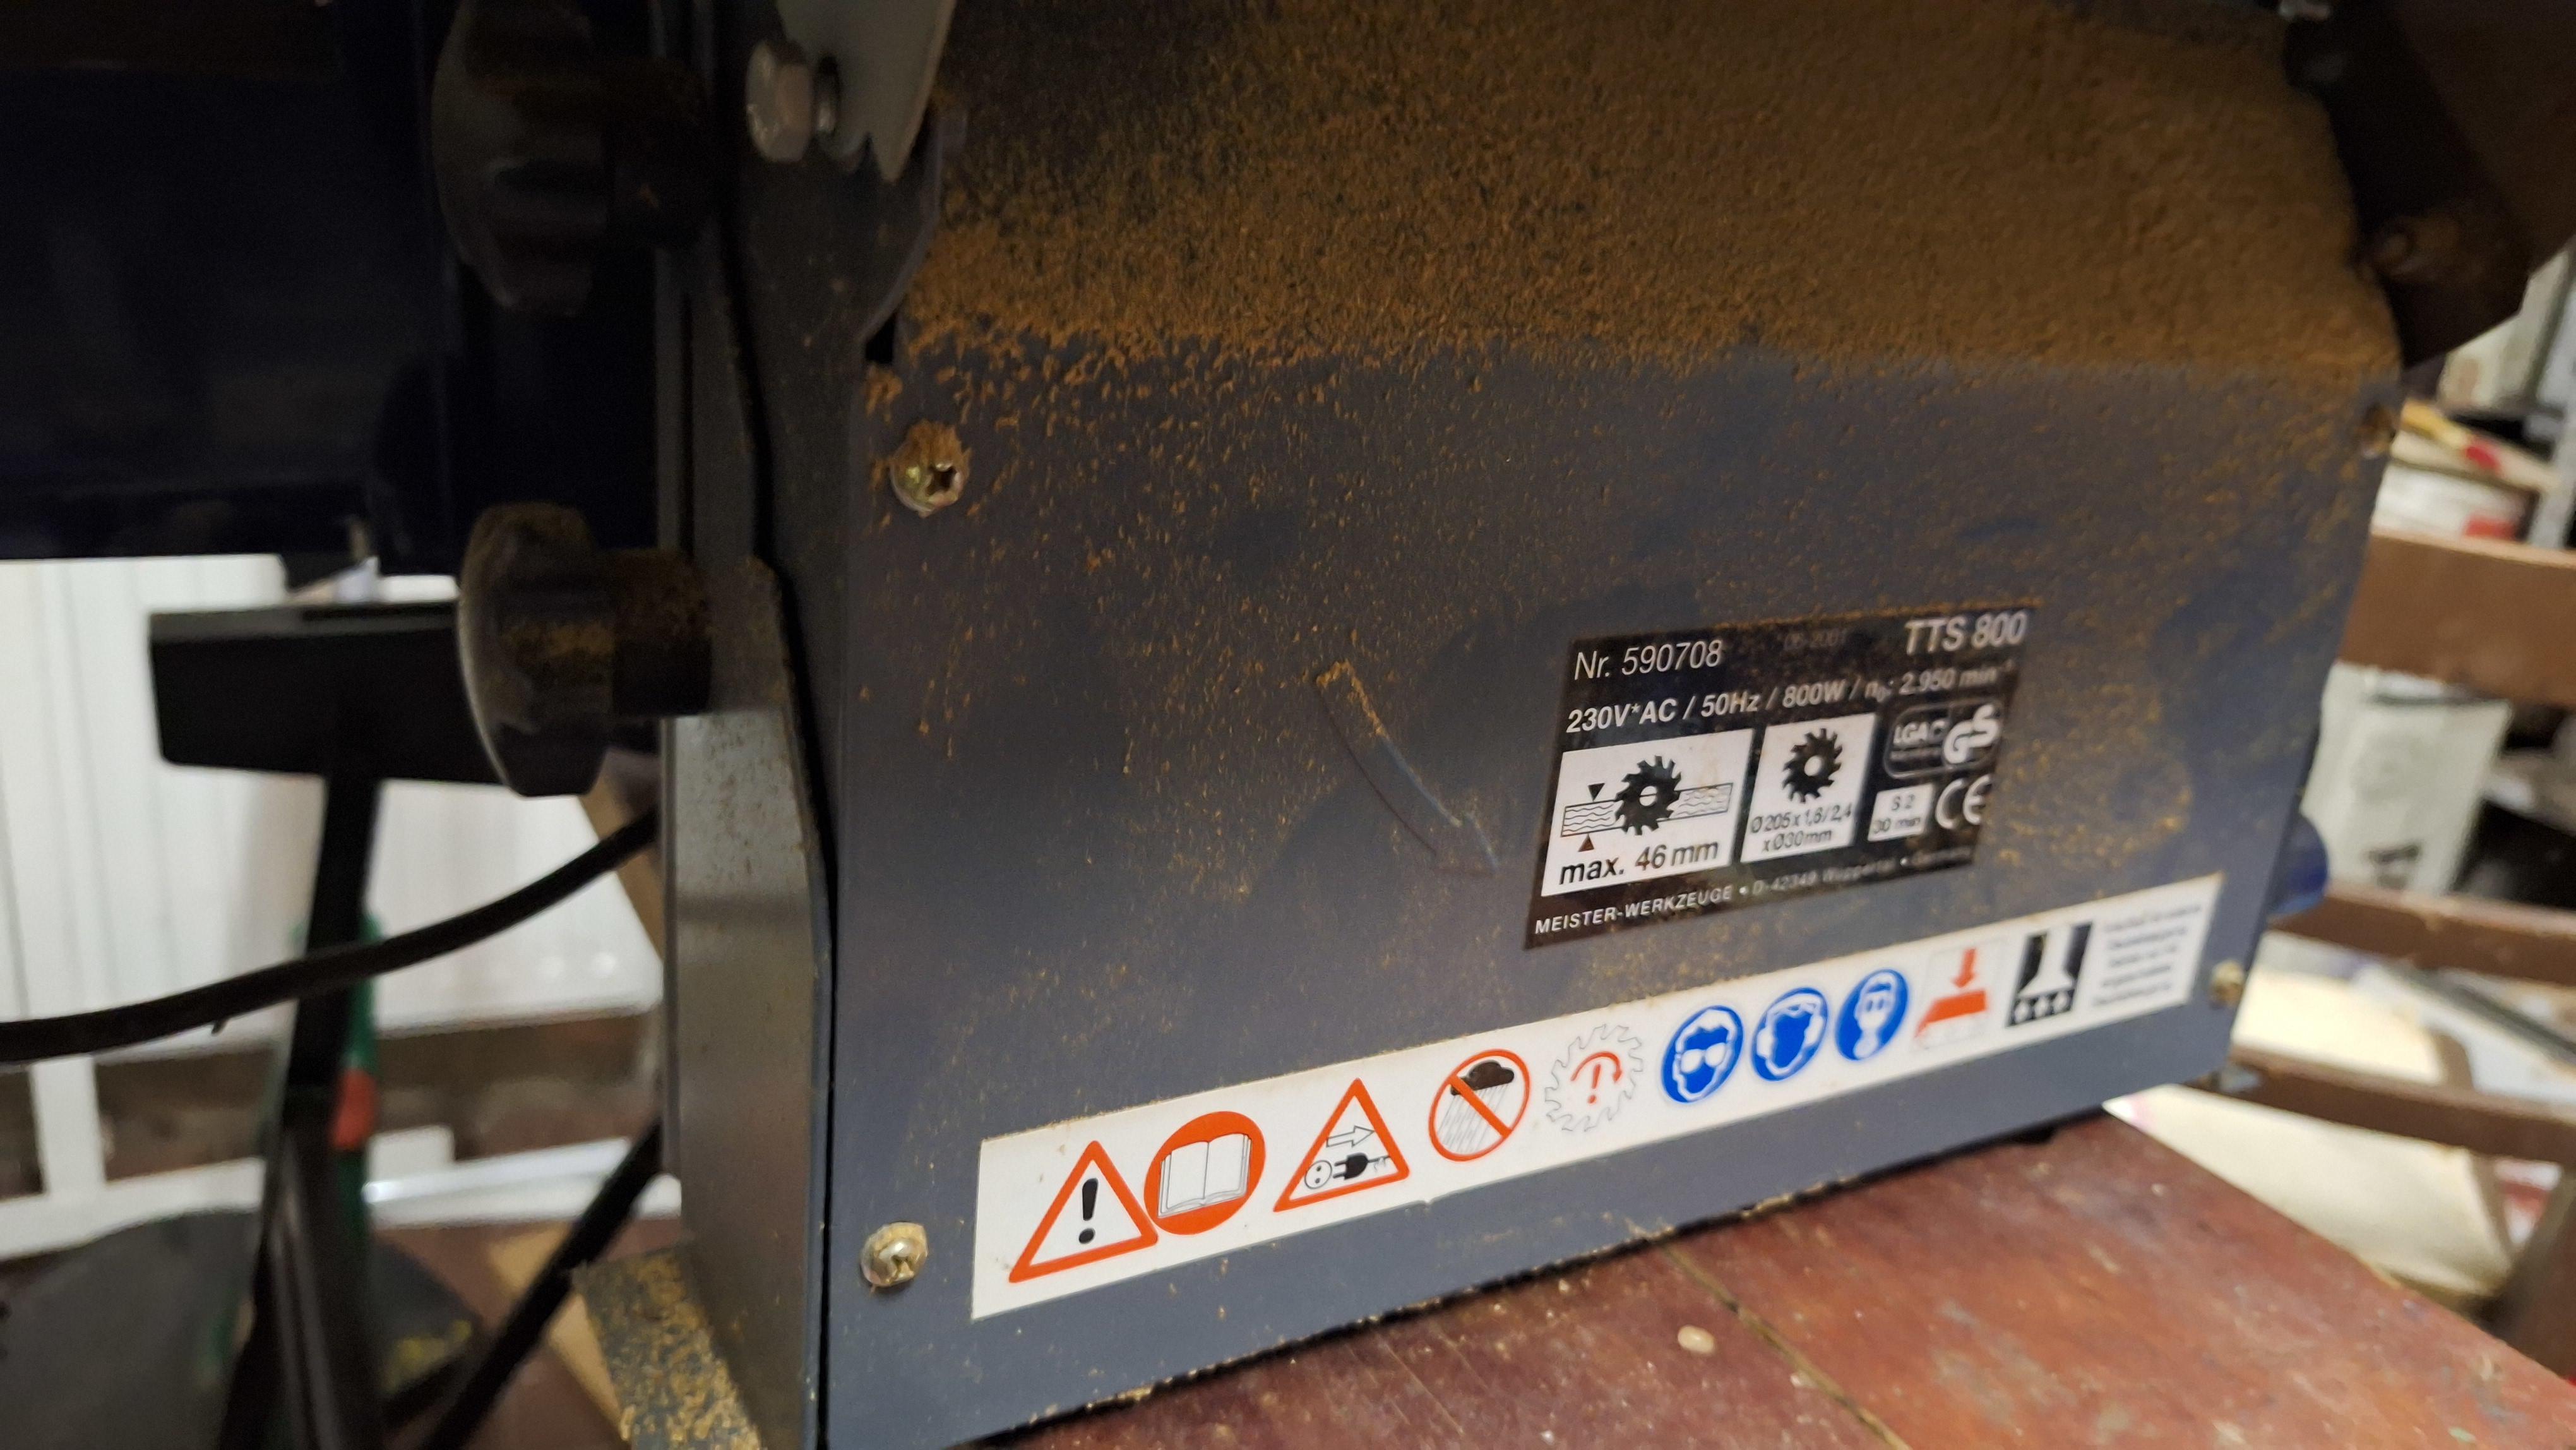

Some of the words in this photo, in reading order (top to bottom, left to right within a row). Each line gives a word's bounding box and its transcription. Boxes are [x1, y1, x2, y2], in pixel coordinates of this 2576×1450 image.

[1905, 616, 1967, 655] TTS
[1972, 610, 2027, 648] 800
[1574, 650, 1609, 680] Nr.
[1621, 639, 1722, 676] 590708
[1700, 691, 1760, 717] 50Hz
[1782, 678, 1848, 708] 800W
[1559, 857, 1625, 885] max.
[1635, 844, 1667, 871] 46
[1671, 841, 1719, 868] mm
[1535, 885, 1733, 935] MEISTER-WERKZEUGE
